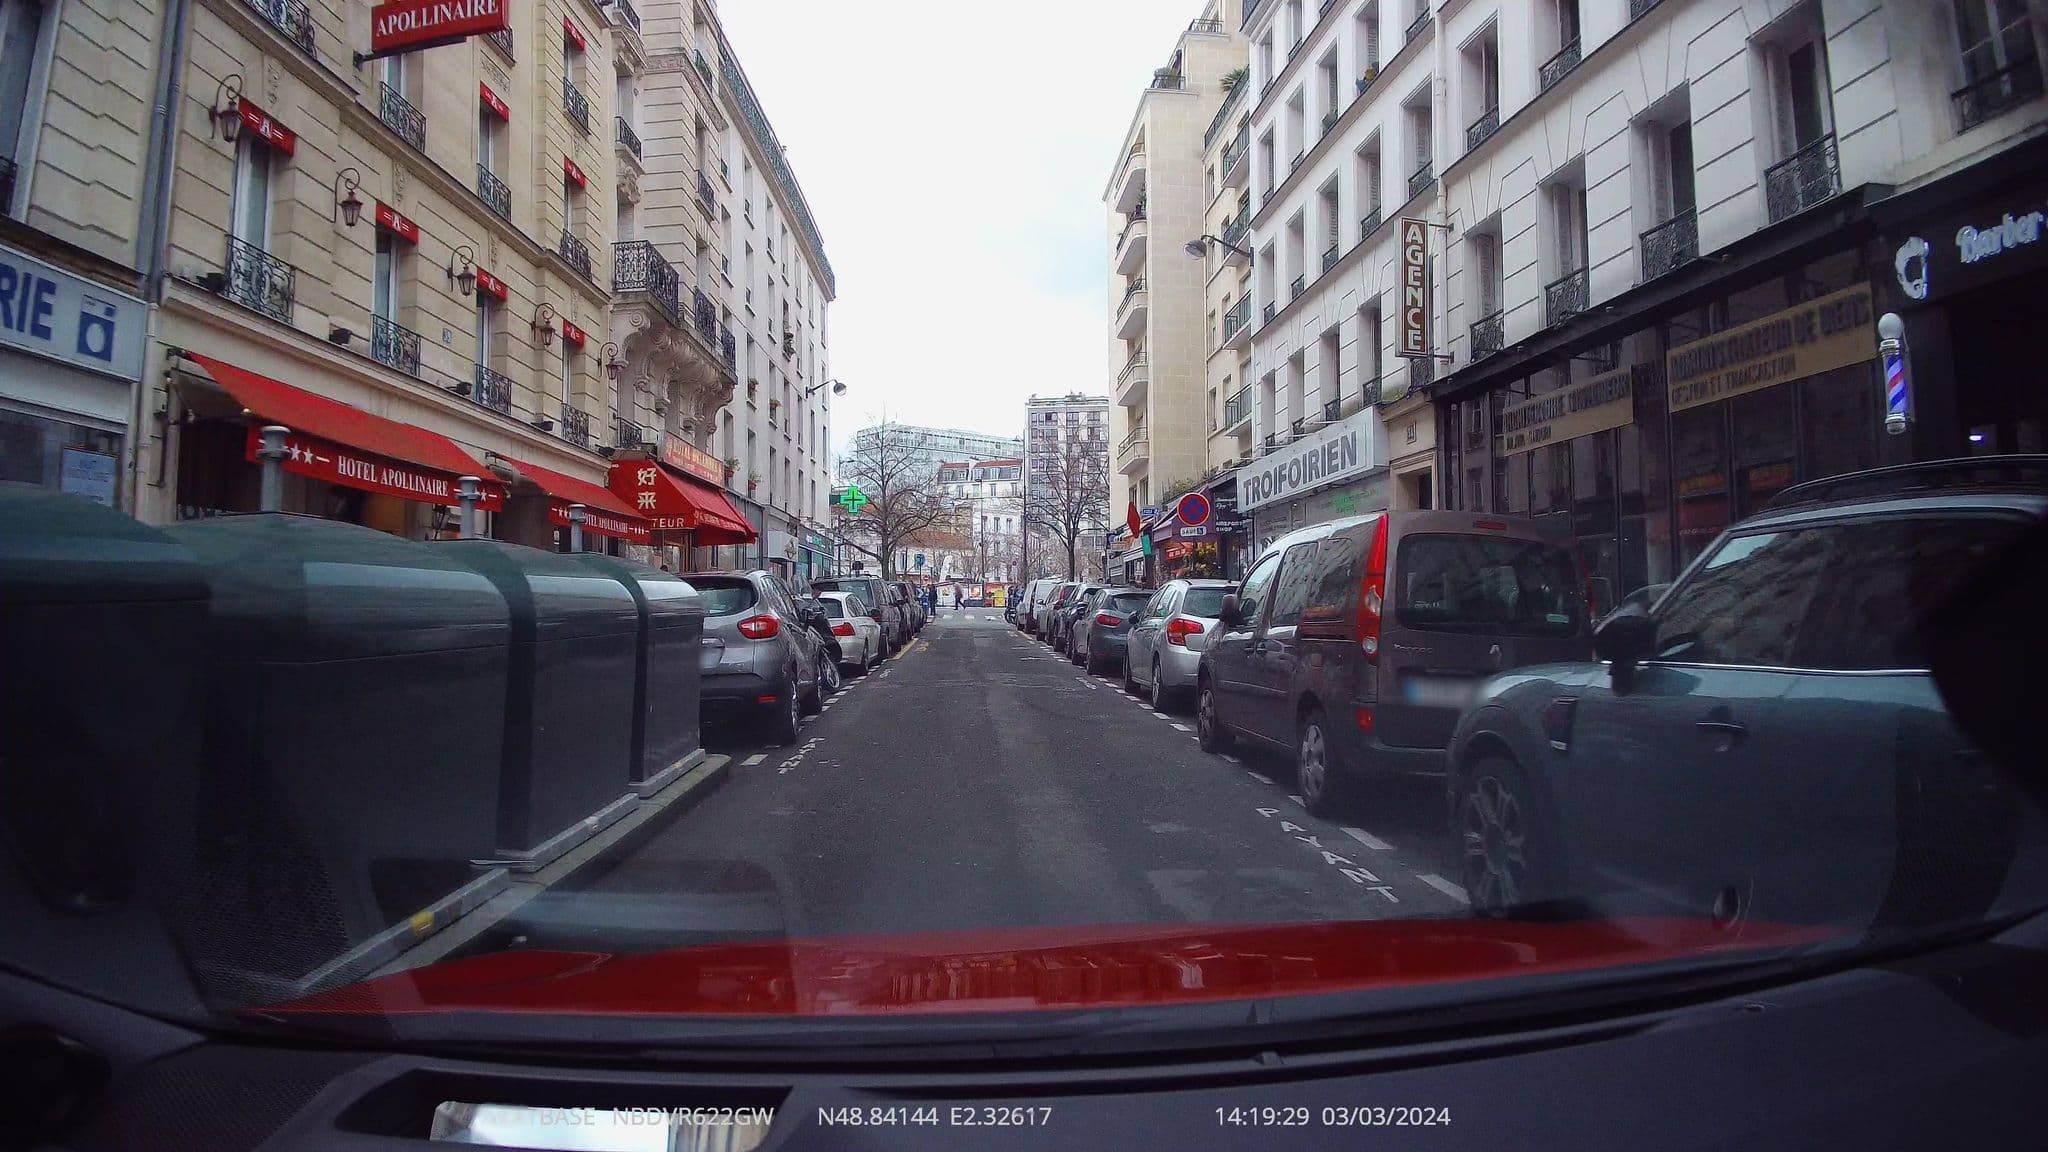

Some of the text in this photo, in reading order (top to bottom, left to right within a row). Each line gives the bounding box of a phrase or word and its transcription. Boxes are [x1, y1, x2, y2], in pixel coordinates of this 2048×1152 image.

[376, 0, 498, 37] APOLLINAIRE
[1405, 224, 1424, 350] AGENCE
[337, 455, 449, 497] HOTEL APOLLINAIRE
[1243, 431, 1357, 506] TROIFOIRIEN
[582, 511, 597, 527] OTEL
[1256, 807, 1399, 903] PAYANT
